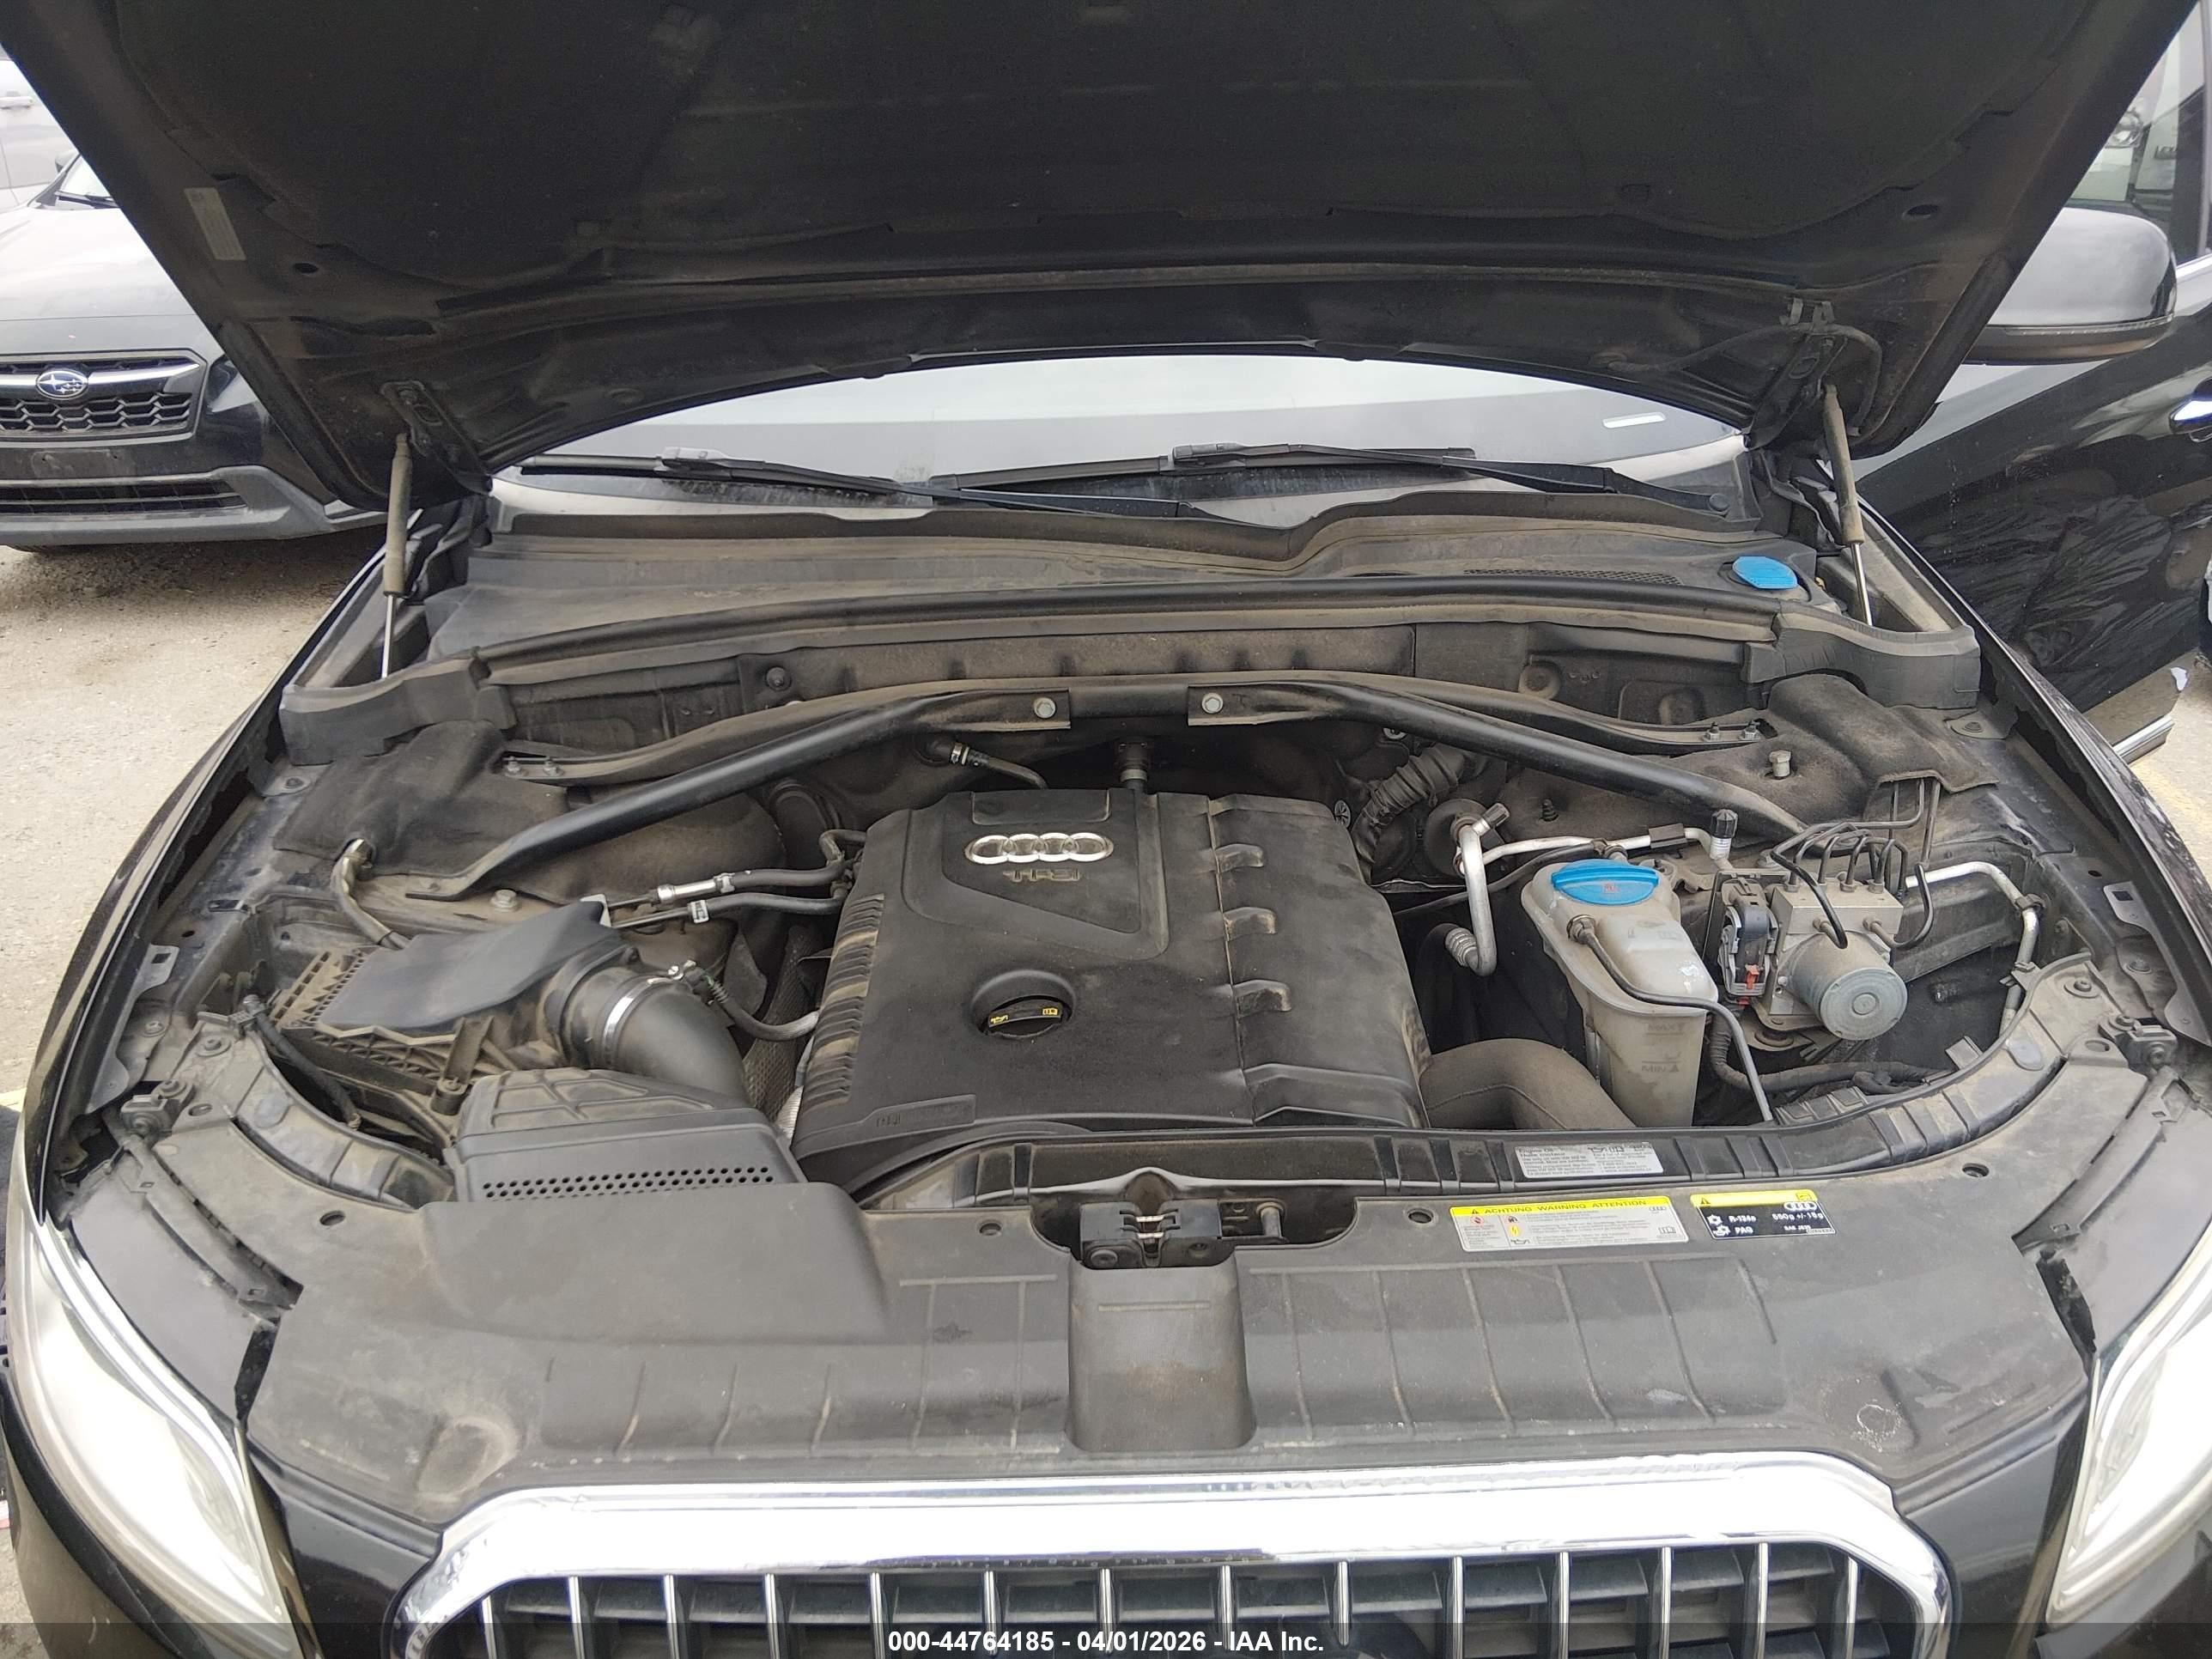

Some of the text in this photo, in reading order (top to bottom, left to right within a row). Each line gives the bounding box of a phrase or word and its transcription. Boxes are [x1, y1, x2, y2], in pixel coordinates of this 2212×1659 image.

[1484, 1200, 1647, 1214] ACHTUNG WARNING ATTENTION
